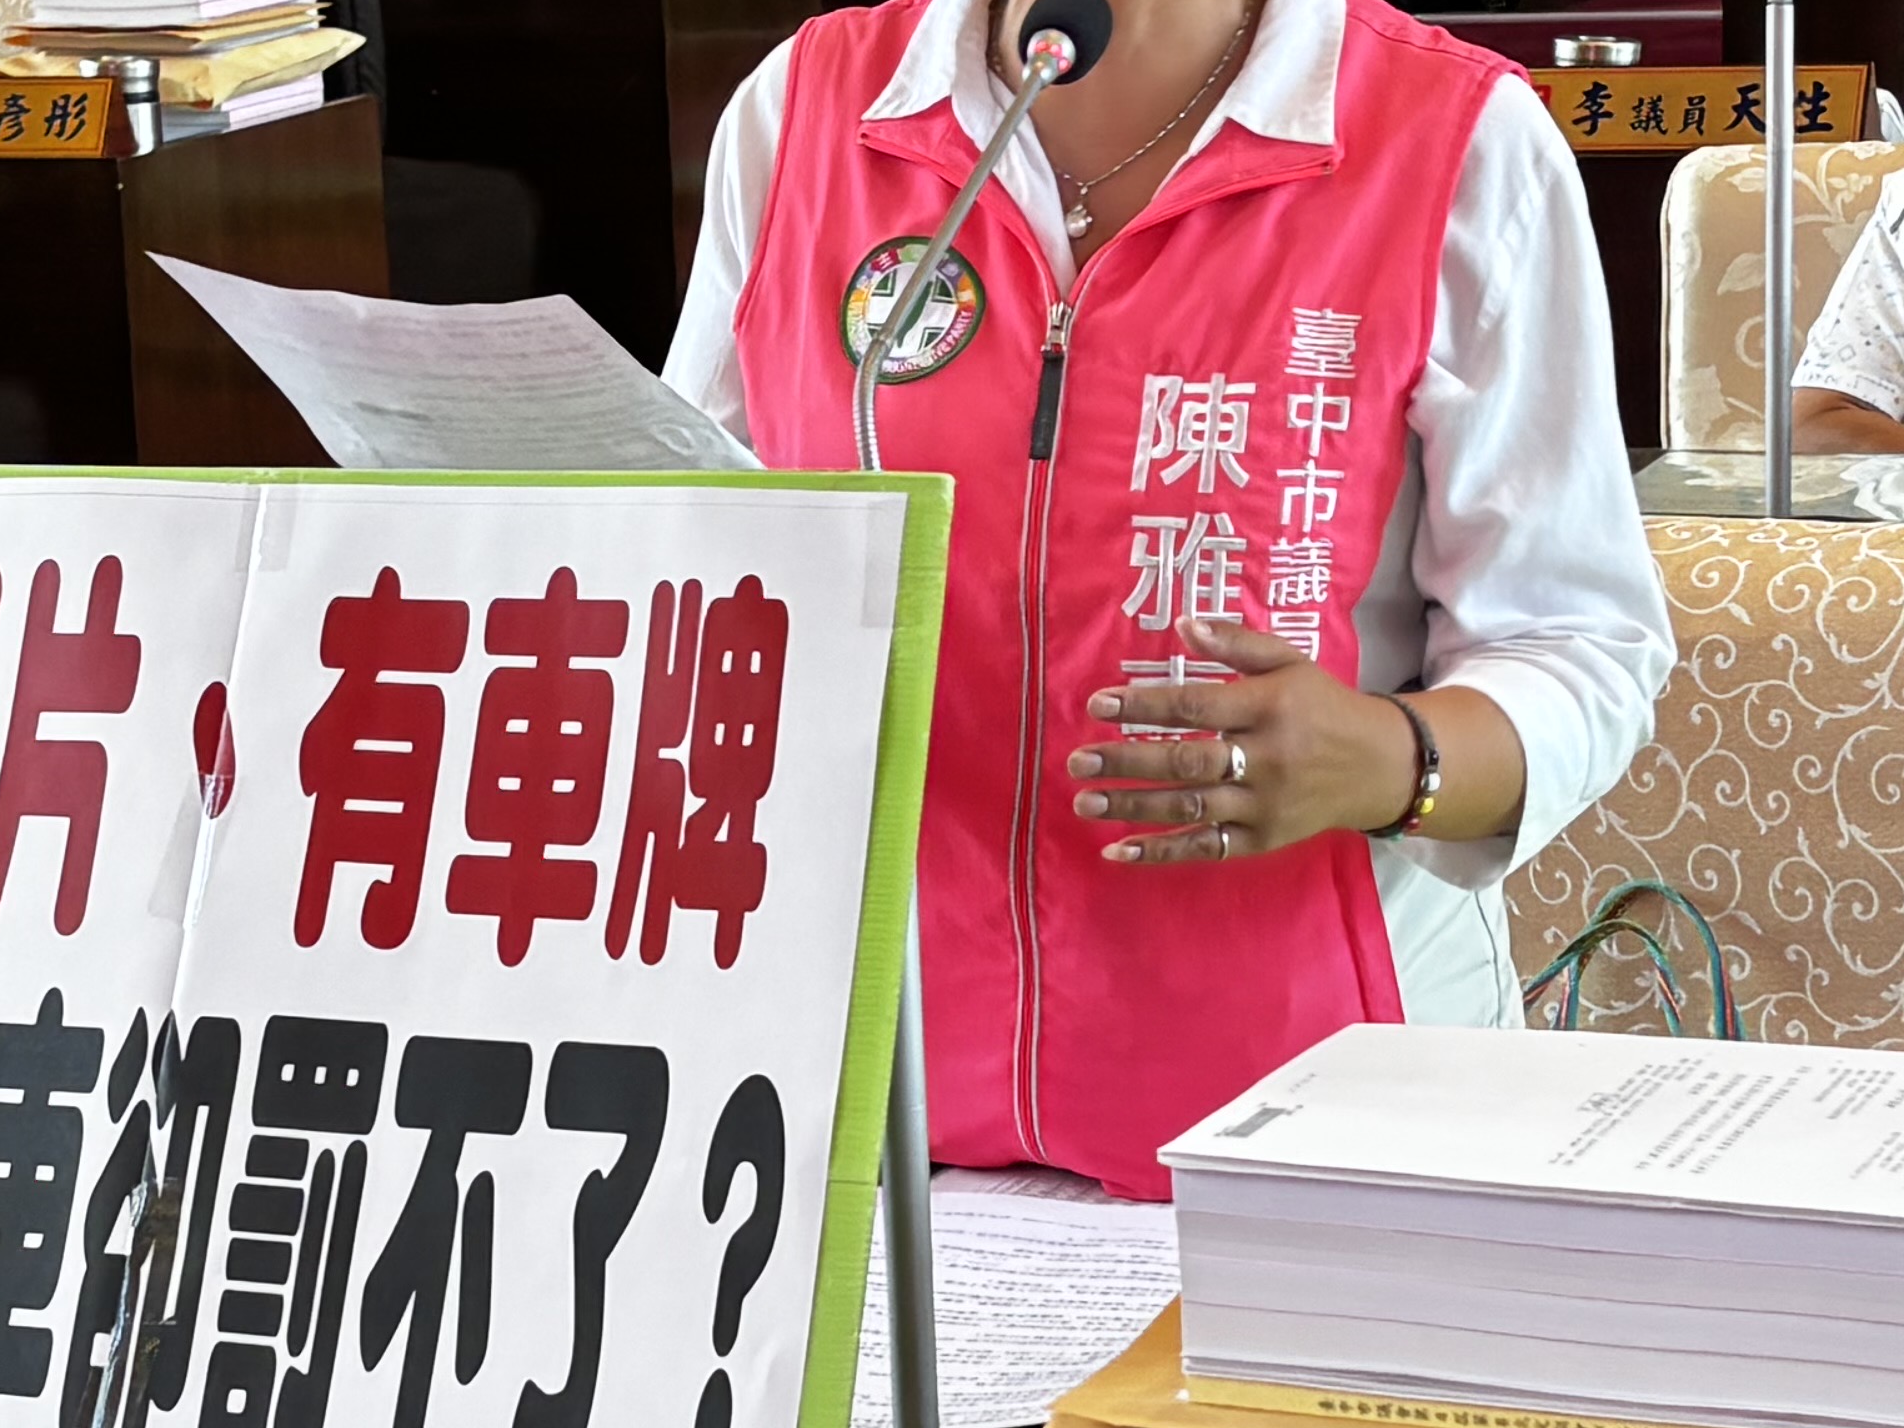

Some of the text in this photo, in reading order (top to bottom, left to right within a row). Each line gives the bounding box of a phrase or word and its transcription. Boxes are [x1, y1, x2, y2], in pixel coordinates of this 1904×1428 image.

[1571, 80, 1834, 137] 李議員天生
[1266, 306, 1363, 663] 臺中市議員
